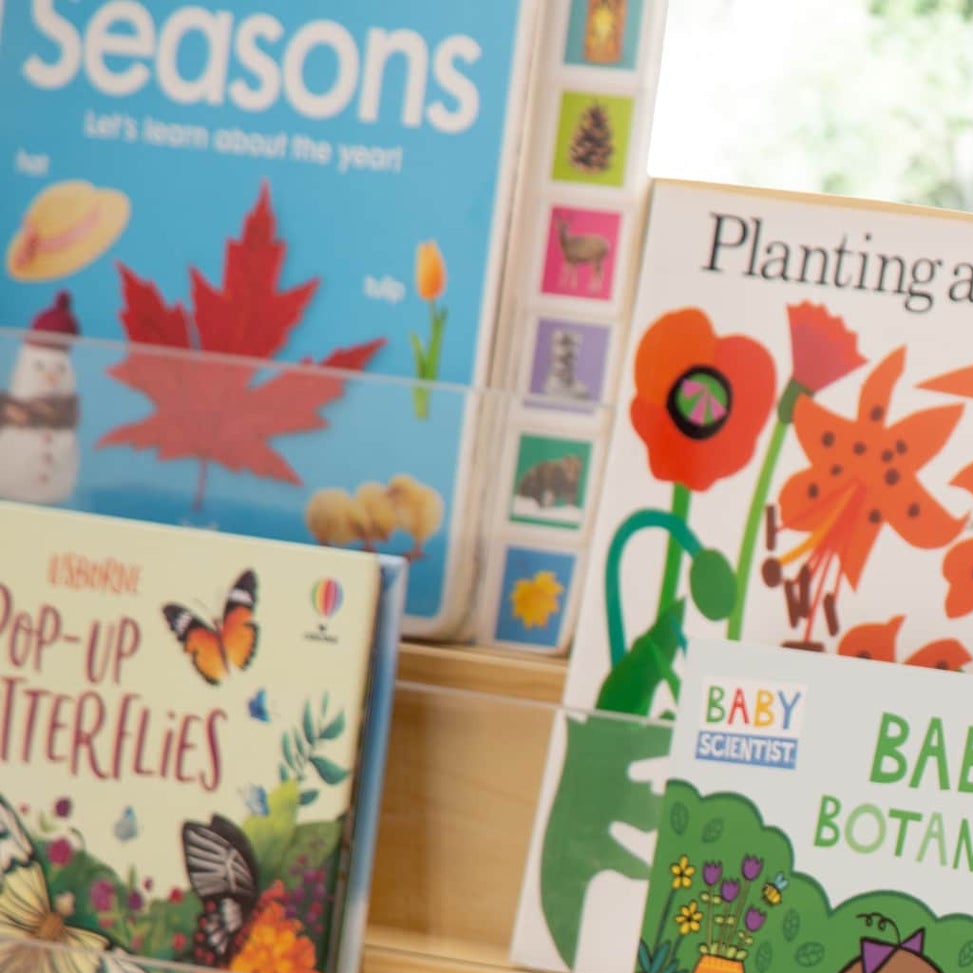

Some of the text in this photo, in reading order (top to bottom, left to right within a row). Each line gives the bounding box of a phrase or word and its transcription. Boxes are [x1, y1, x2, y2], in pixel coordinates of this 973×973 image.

[22, 0, 482, 135] Seasons
[15, 147, 50, 177] hat
[84, 109, 403, 174] Let's learn about the year!
[701, 212, 942, 315] Planting
[363, 275, 406, 305] tulip
[705, 684, 802, 730] BABY
[699, 733, 796, 763] SCIENTIST
